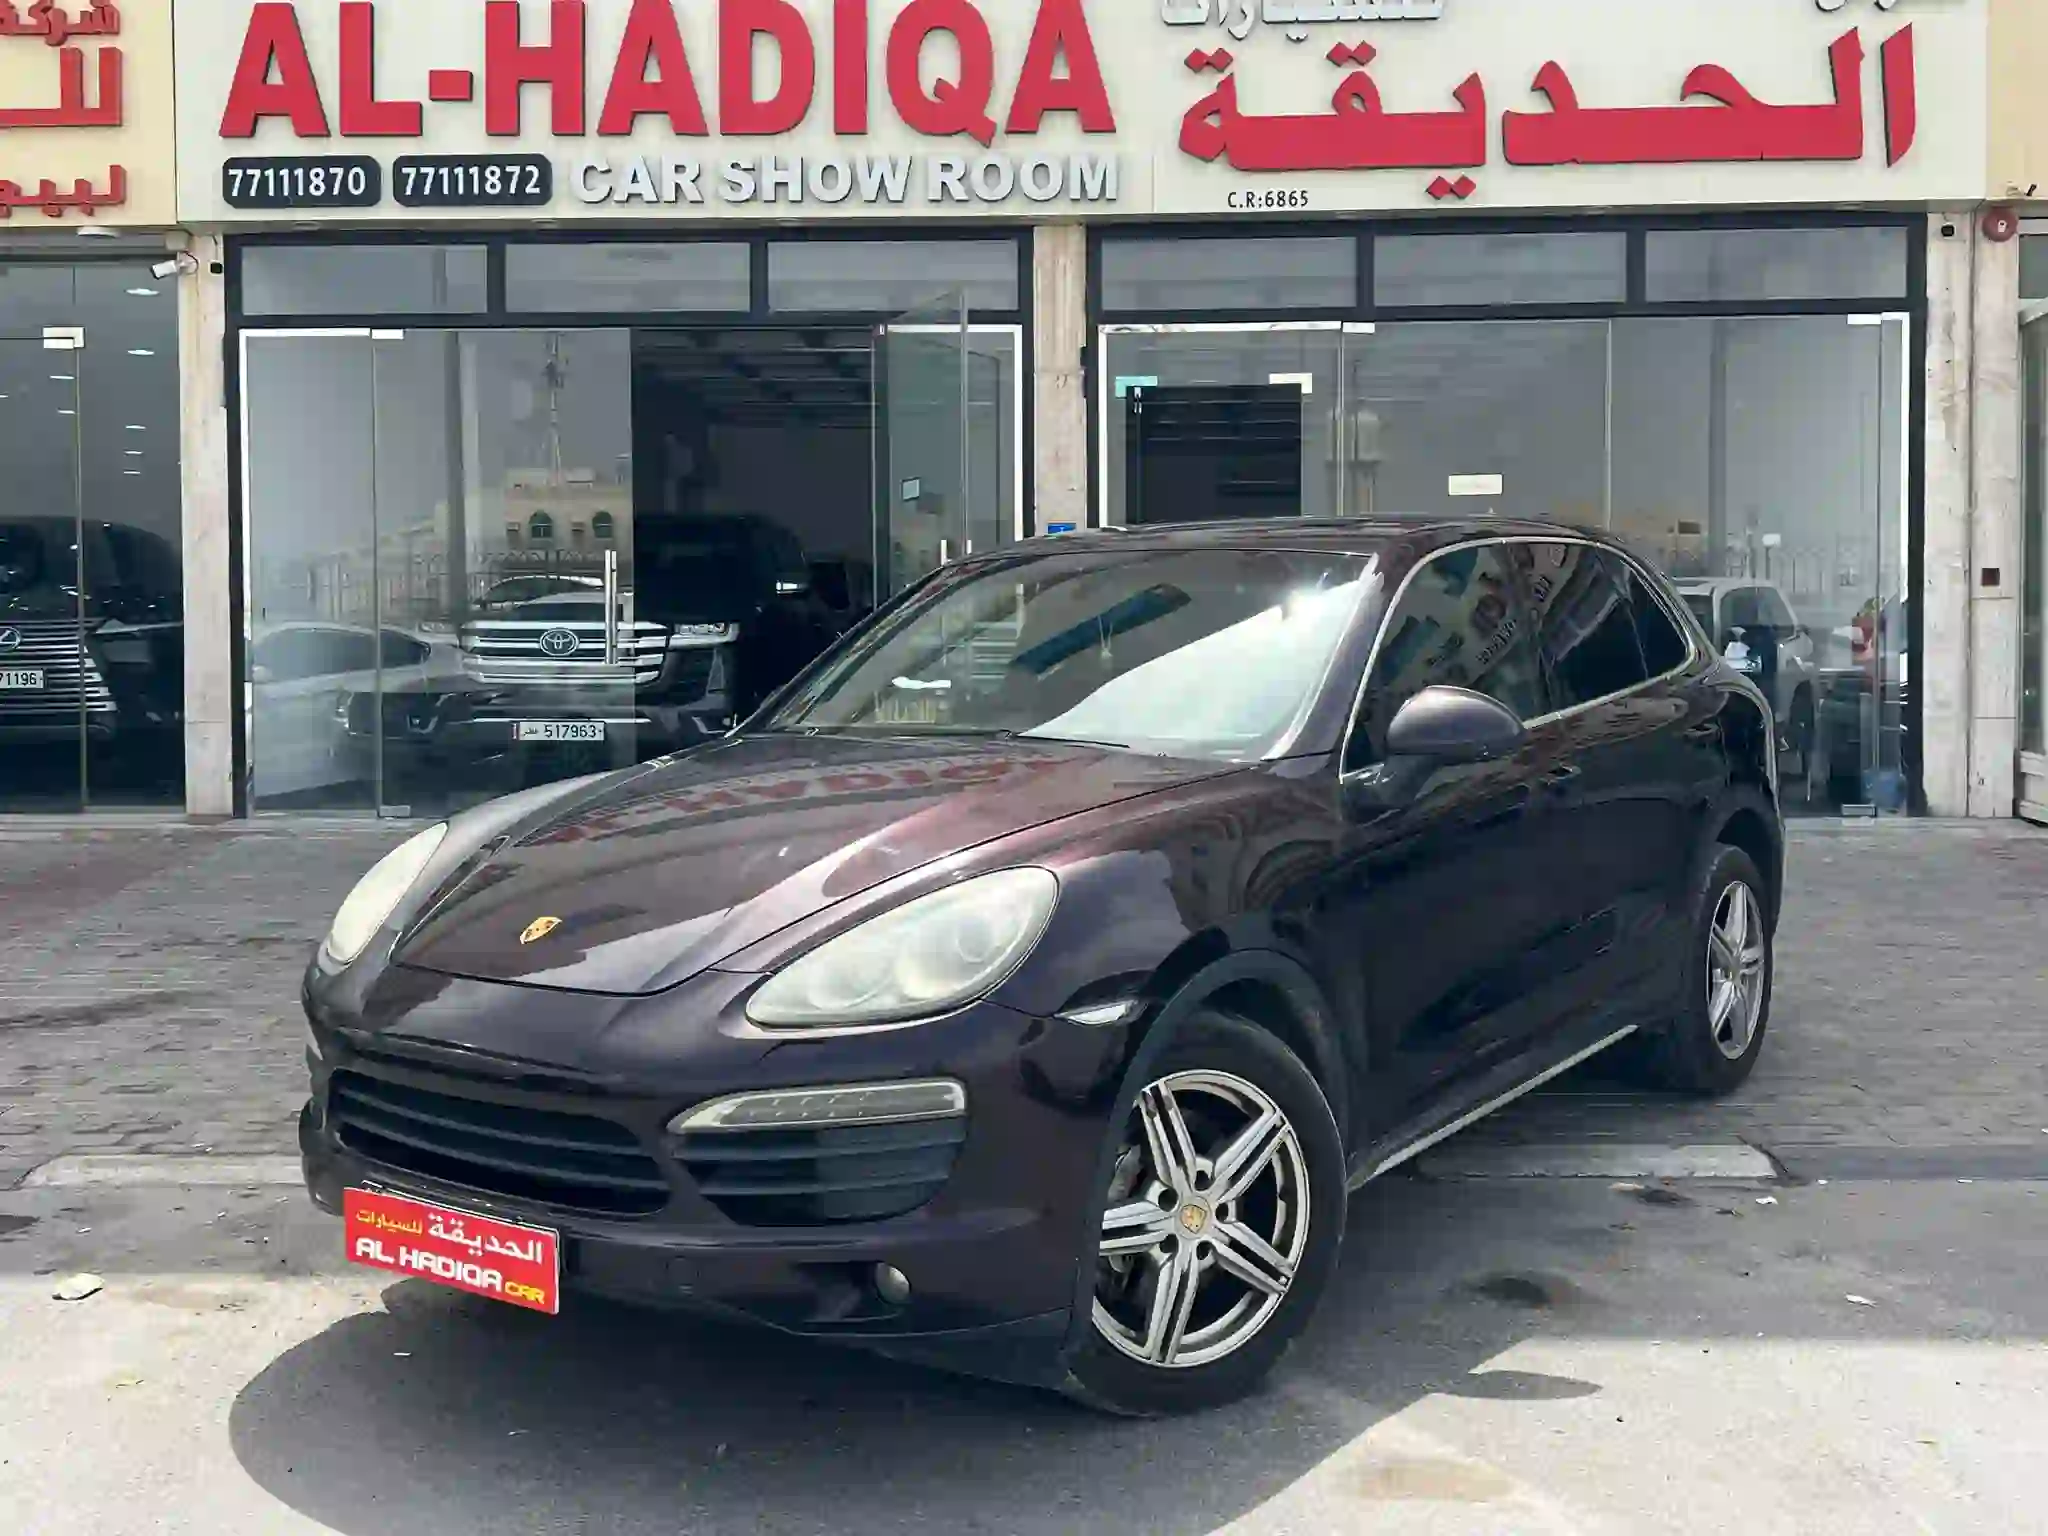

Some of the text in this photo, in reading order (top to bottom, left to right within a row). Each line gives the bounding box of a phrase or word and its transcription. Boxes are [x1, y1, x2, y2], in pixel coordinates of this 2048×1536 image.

[219, 0, 1117, 147] AL-HADIQA
[1179, 22, 1914, 200] الحديقة
[228, 166, 366, 198] 77111870
[401, 165, 541, 197] 77111872
[577, 153, 1118, 204] CAR SHOW ROOM
[1227, 190, 1309, 209] C.R:6865
[543, 723, 597, 739] 517963
[356, 1208, 543, 1265] الحديقة للسيارات
[356, 1237, 546, 1306] AL HADIQA CAR
